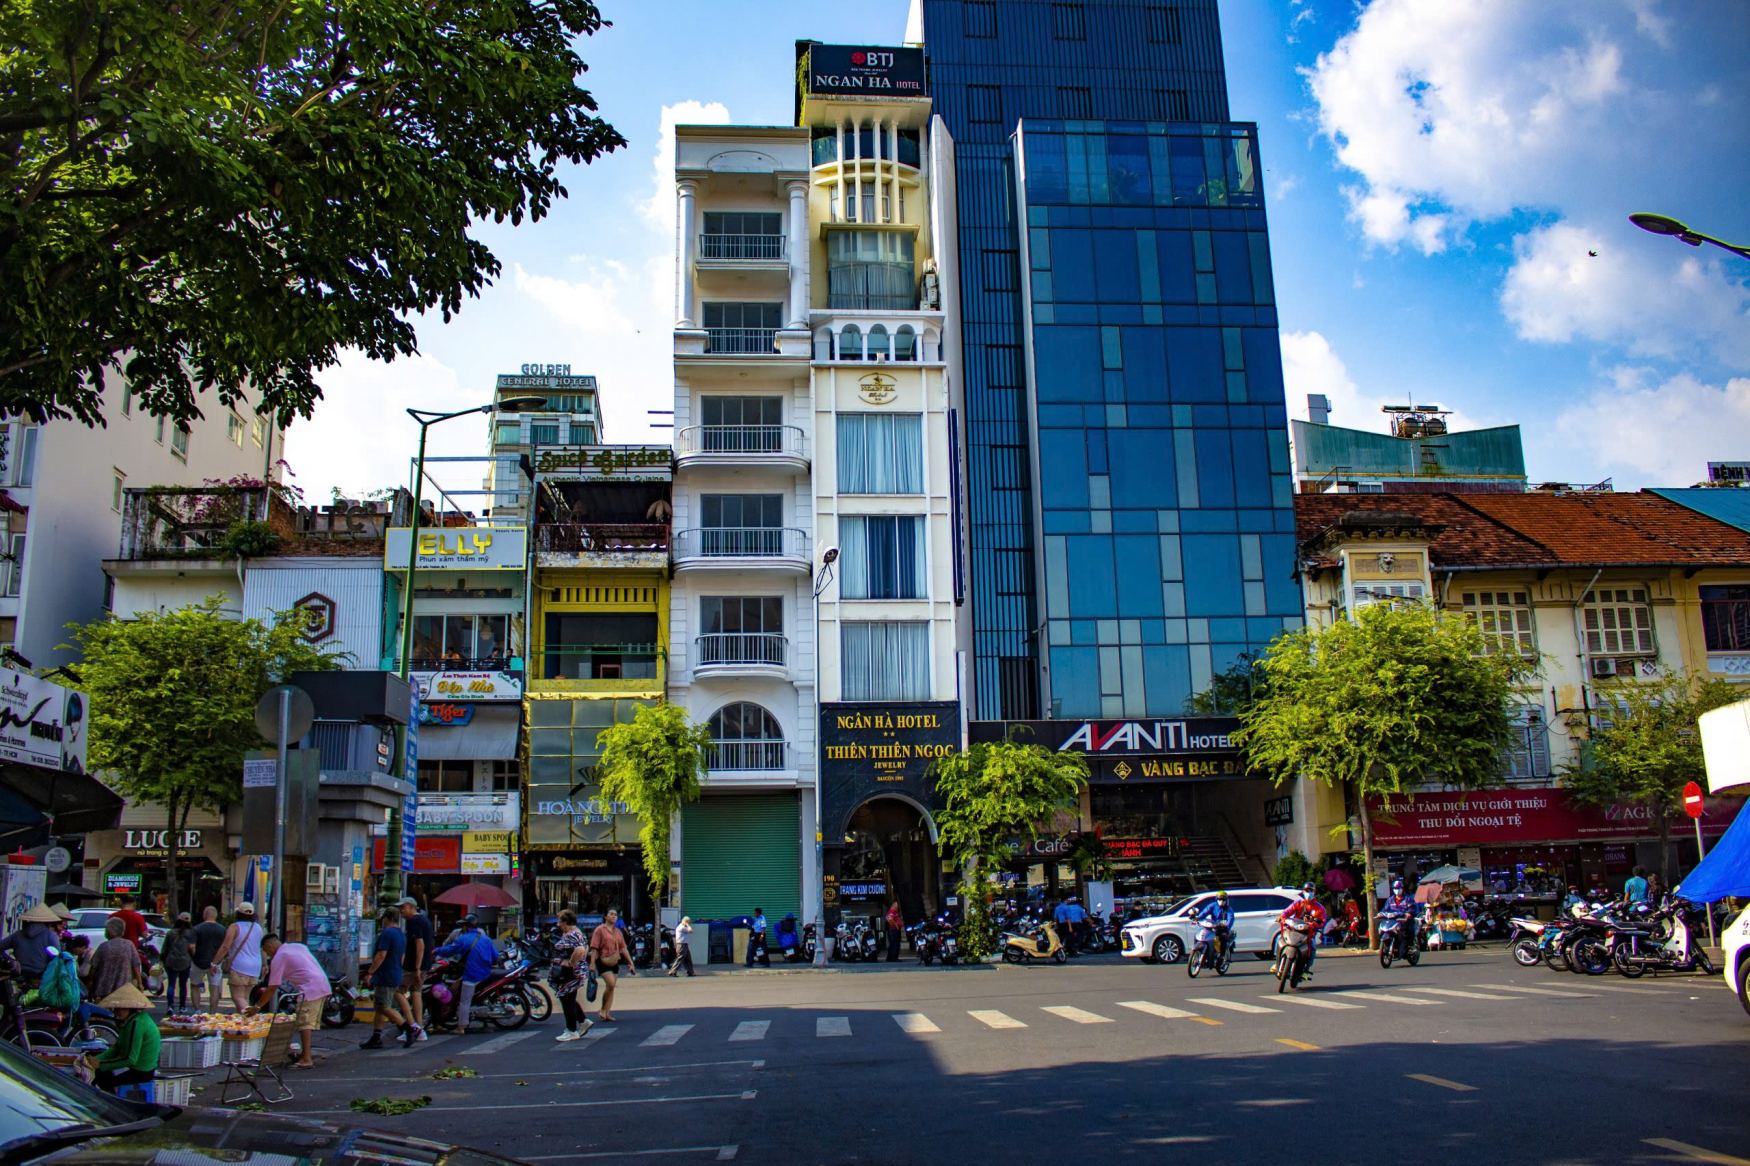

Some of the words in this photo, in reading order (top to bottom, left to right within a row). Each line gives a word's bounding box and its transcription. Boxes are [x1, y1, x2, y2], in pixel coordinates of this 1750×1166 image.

[867, 52, 894, 67] BTJ
[815, 75, 864, 87] NGAN
[868, 77, 892, 88] HA
[896, 81, 920, 89] HOTEL
[521, 363, 571, 376] GOLDEN
[502, 377, 549, 386] CENTRAL
[556, 377, 592, 386] HOTEL
[537, 446, 588, 472] Spice
[592, 446, 669, 475] Garden
[1712, 464, 1744, 481] BỆNH
[296, 505, 365, 531] NTC
[418, 533, 492, 555] ELLY
[437, 679, 463, 694] Bếp
[467, 679, 495, 694] Nhà
[430, 703, 467, 722] Tiger
[837, 712, 871, 729] NGÂN
[875, 711, 893, 728] HÀ
[897, 714, 941, 728] HOTEL
[1058, 722, 1188, 751] AVANTI
[1190, 735, 1236, 748] HOTEL
[825, 742, 867, 759] THIÊN
[869, 741, 910, 758] THIÊN
[1141, 760, 1184, 777] VÀNG
[1188, 761, 1219, 777] BẠC
[538, 799, 601, 815] HOÀNG
[1266, 798, 1290, 815] AANTI
[1378, 803, 1415, 813] TRUNG
[1417, 801, 1440, 812] TÂM
[1443, 802, 1470, 814] DỊCH
[1471, 801, 1487, 812] VỤ
[1489, 798, 1512, 810] GIỚI
[1515, 797, 1547, 810] THIỆU
[415, 810, 449, 823] BABY
[457, 811, 503, 823] SPOON
[574, 815, 613, 826] JEWELRY
[1419, 818, 1442, 828] THU
[1445, 813, 1466, 828] ĐỔI
[1468, 816, 1504, 828] NGOẠI
[1507, 813, 1521, 828] TỆ
[1034, 838, 1069, 853] Café
[858, 884, 867, 894] KIM
